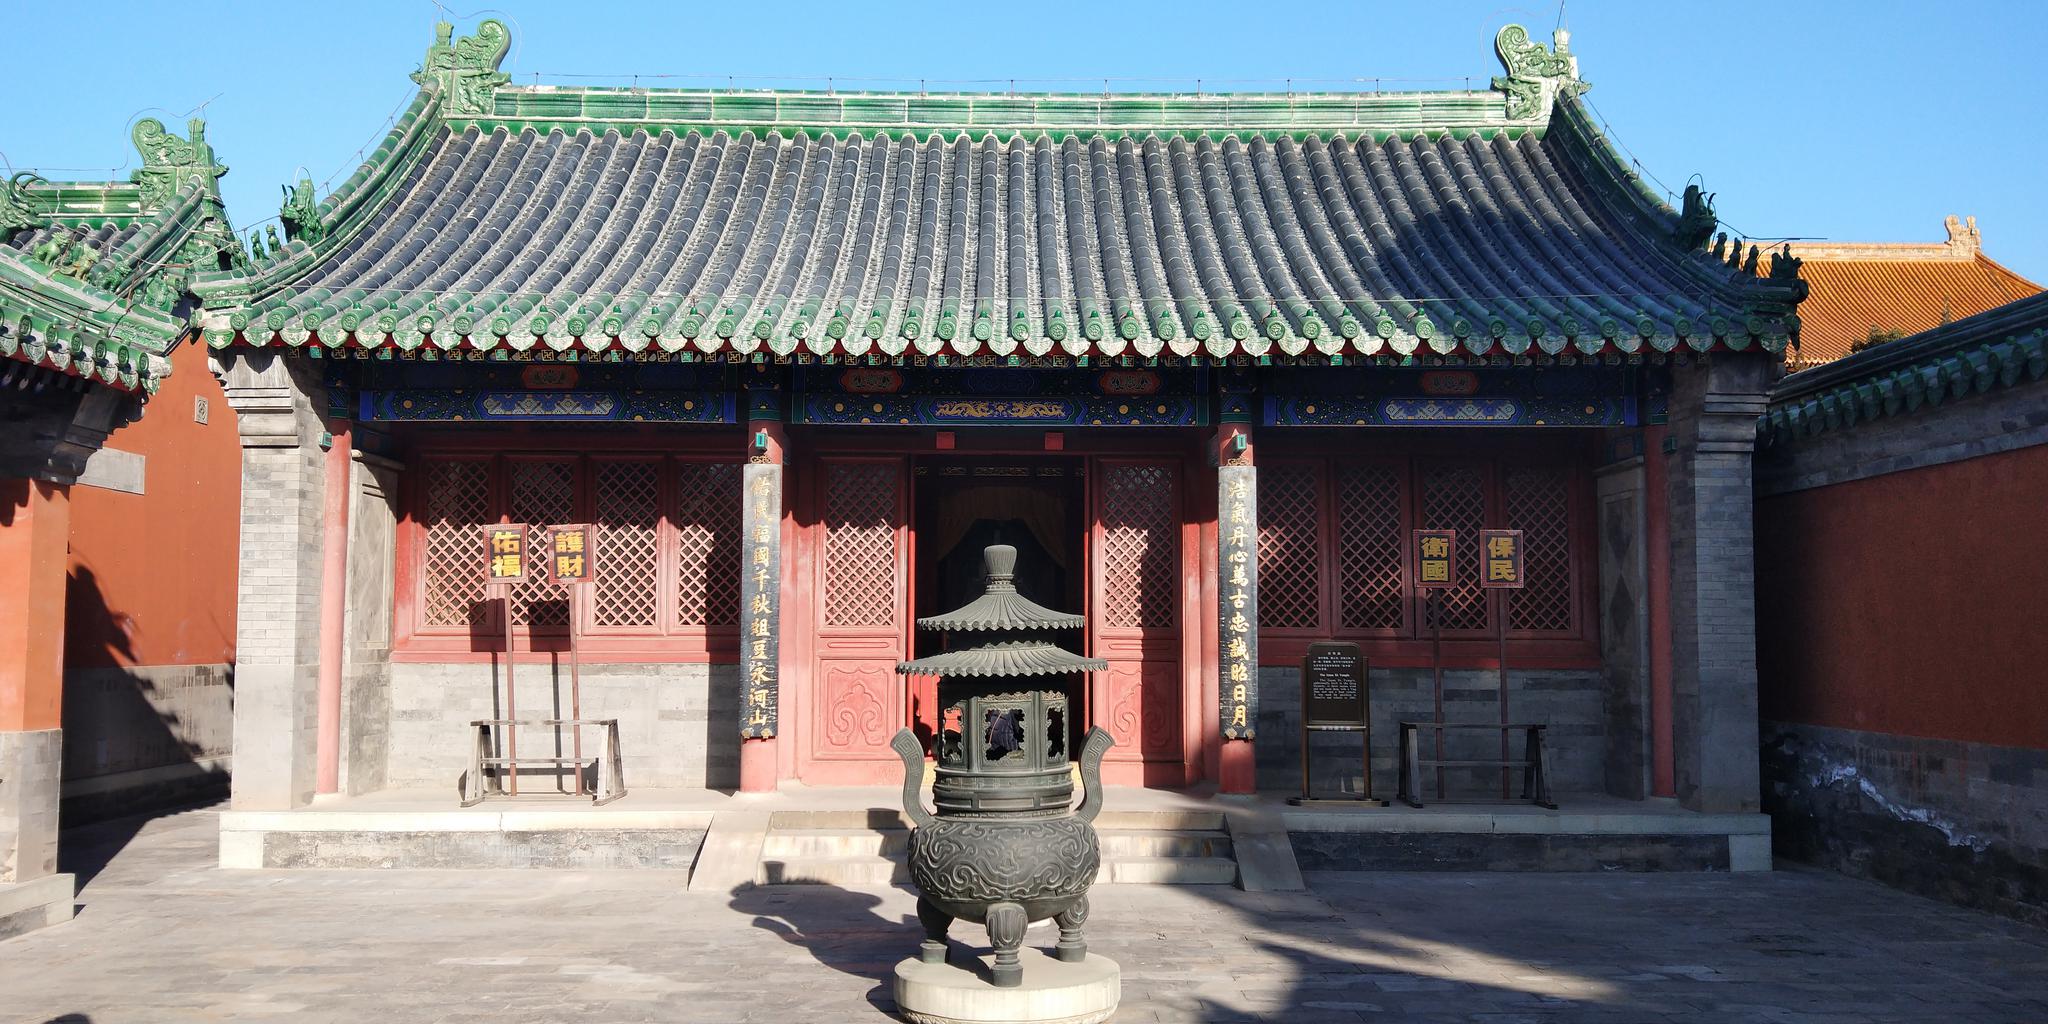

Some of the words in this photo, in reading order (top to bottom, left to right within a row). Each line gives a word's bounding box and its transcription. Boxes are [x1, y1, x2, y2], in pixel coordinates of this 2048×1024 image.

[491, 532, 521, 577] 佑福
[555, 532, 584, 577] 護財
[1421, 537, 1449, 581] 衛國
[1488, 537, 1517, 581] 保民
[1228, 479, 1250, 727] 浩氣丹心萬古忠誠昭日月
